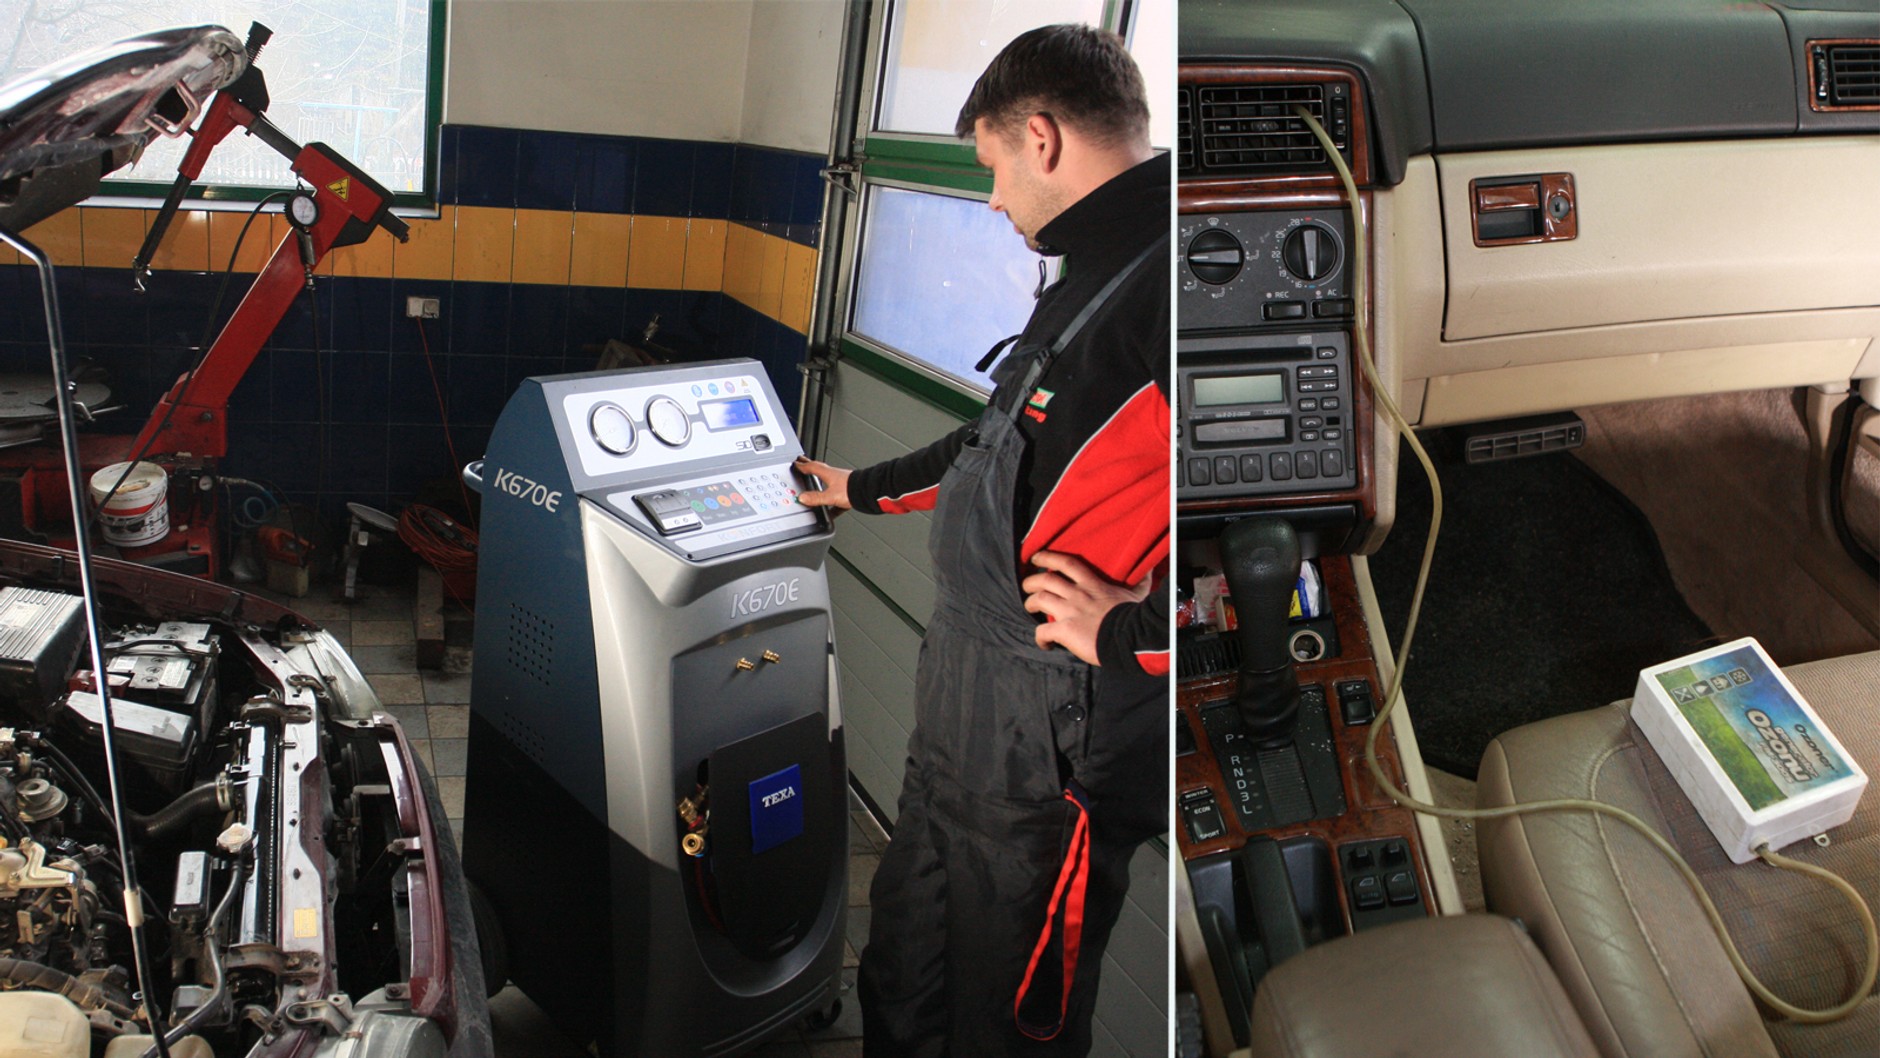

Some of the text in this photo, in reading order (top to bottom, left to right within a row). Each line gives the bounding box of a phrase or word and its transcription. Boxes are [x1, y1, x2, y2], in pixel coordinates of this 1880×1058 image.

[1271, 250, 1281, 258] 22
[1279, 269, 1287, 277] 19
[494, 467, 562, 513] K670E
[730, 578, 799, 619] K670E
[1225, 733, 1234, 743] P
[1745, 708, 1812, 782] Ozonu
[1231, 755, 1240, 765] R
[1233, 767, 1243, 777] N
[1236, 780, 1247, 789] D
[762, 786, 795, 808] TEXA
[1185, 789, 1208, 799] WINTER
[1240, 792, 1249, 801] 3
[1194, 805, 1211, 814] ECON
[1242, 805, 1252, 814] L
[1200, 829, 1219, 840] SPORT
